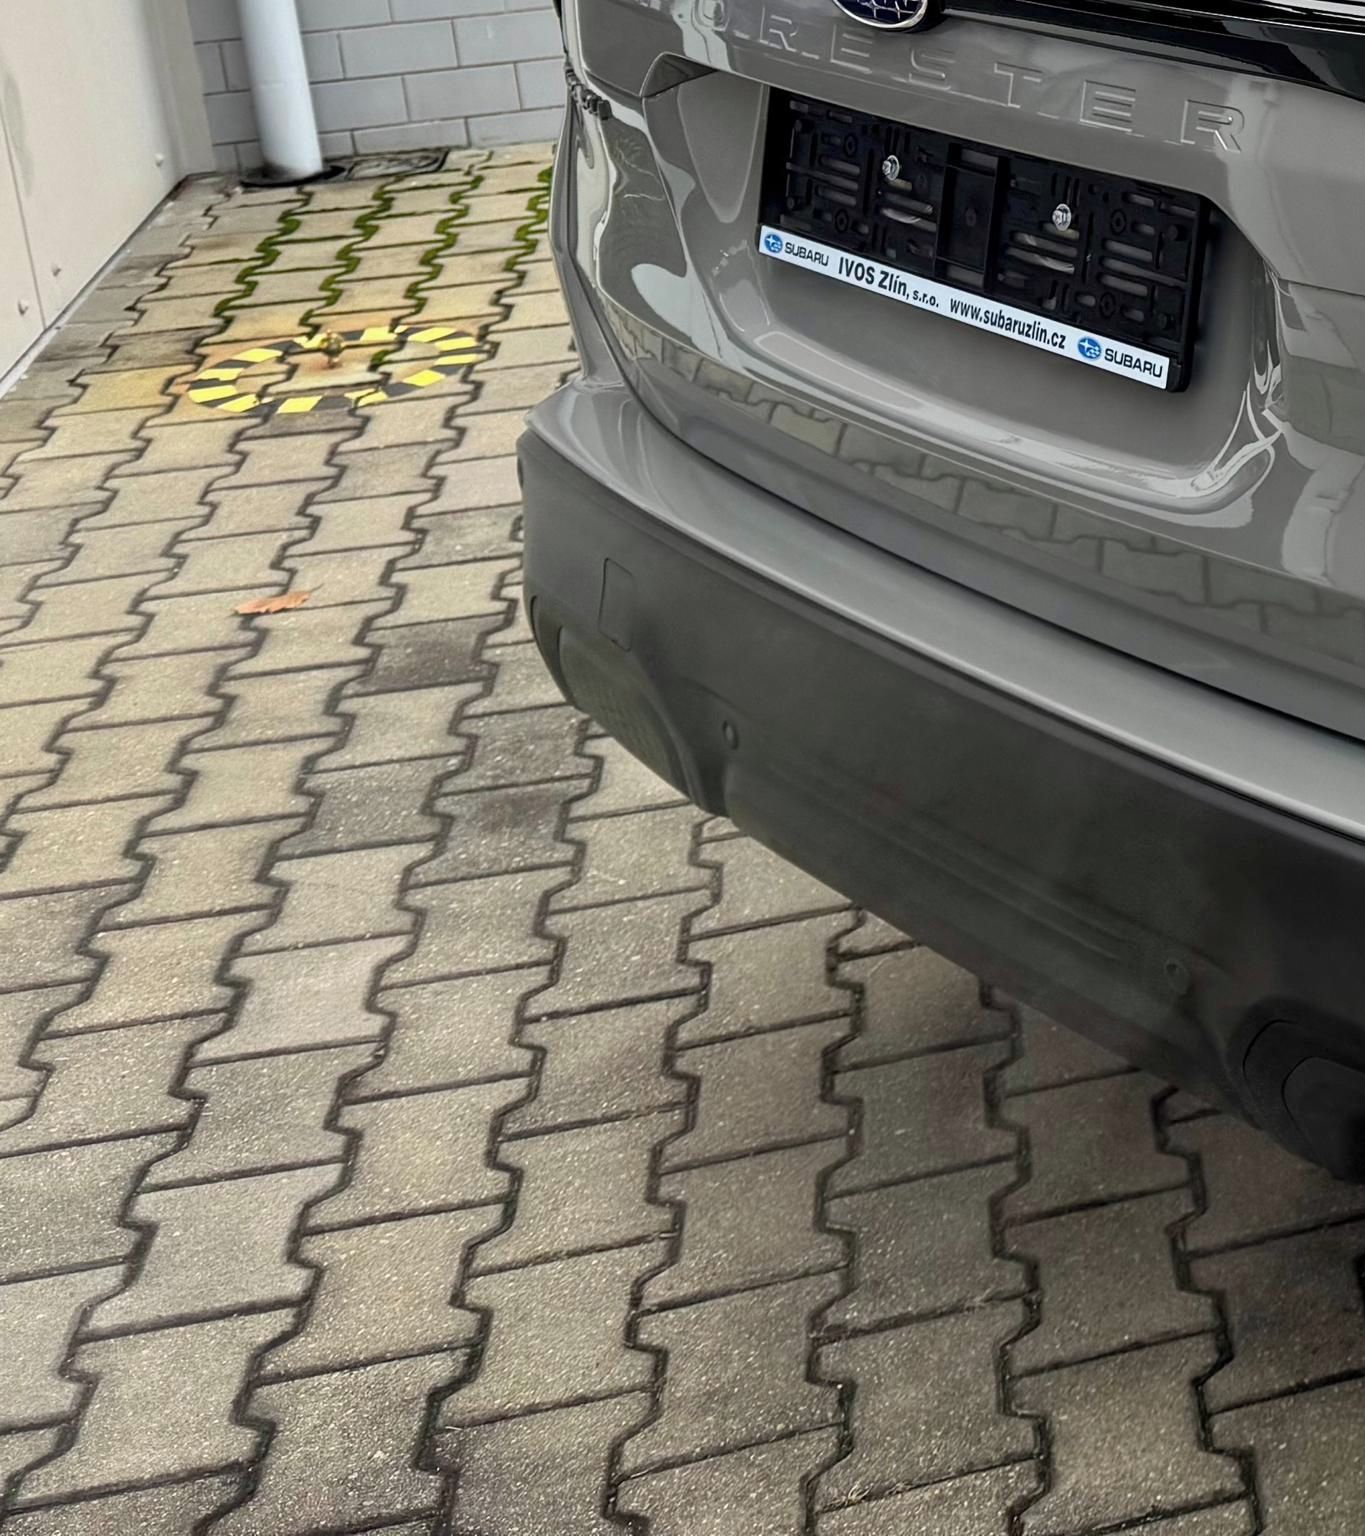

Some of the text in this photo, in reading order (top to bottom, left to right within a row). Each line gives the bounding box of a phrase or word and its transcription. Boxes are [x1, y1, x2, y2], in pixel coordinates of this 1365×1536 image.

[784, 241, 1163, 378] SUBARU IVOS Zlín, s.r.o. www.subaruzlin.cz SUBARU
